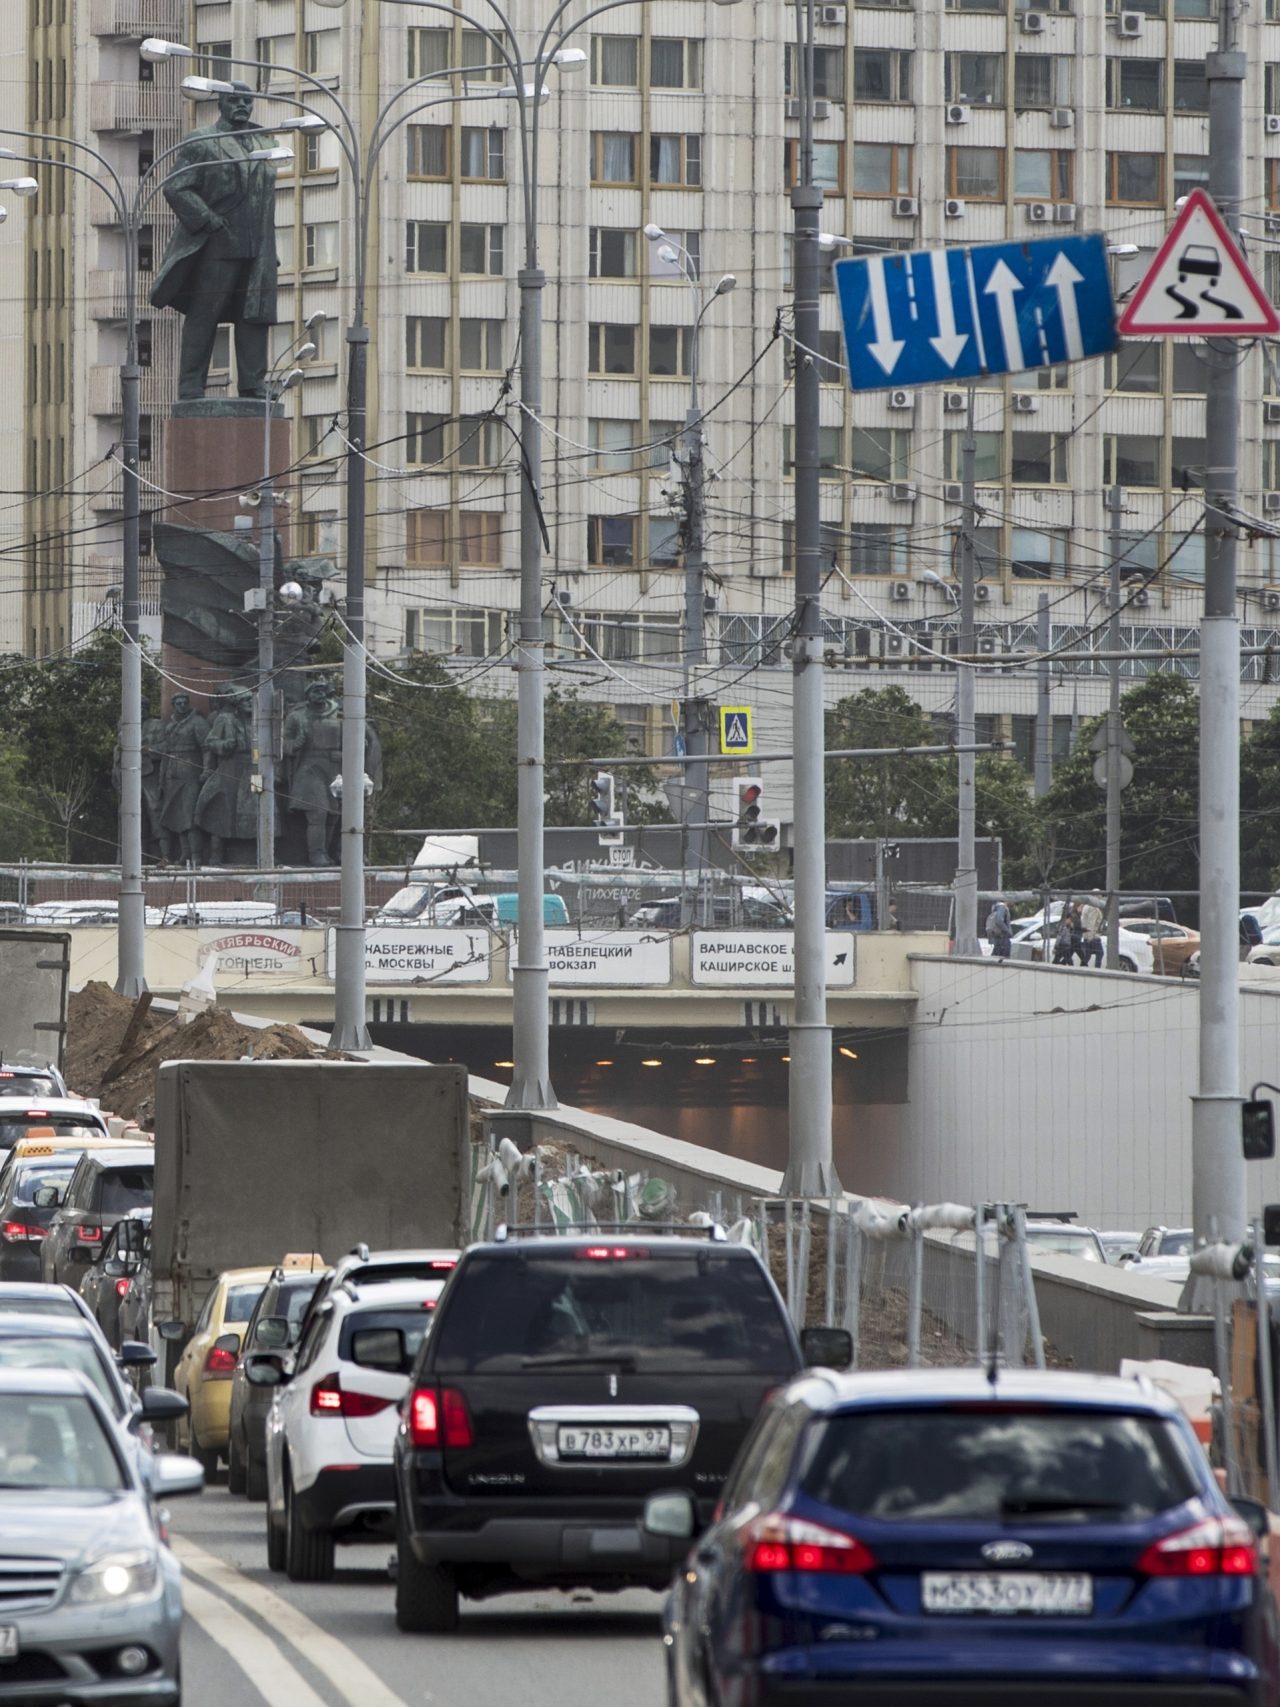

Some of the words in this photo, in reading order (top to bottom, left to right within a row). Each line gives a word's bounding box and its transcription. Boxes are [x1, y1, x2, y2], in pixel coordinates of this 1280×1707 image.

[612, 849, 631, 859] СТОП
[365, 944, 454, 956] НАБЕРЕЖНЫЕ
[548, 945, 633, 959] ПАВЕЛЕЦКИЙ
[700, 943, 787, 955] ВАРШАВСКОЕ
[378, 958, 434, 969] МОСКВЫ
[700, 961, 778, 972] КАШИРСКОЕ
